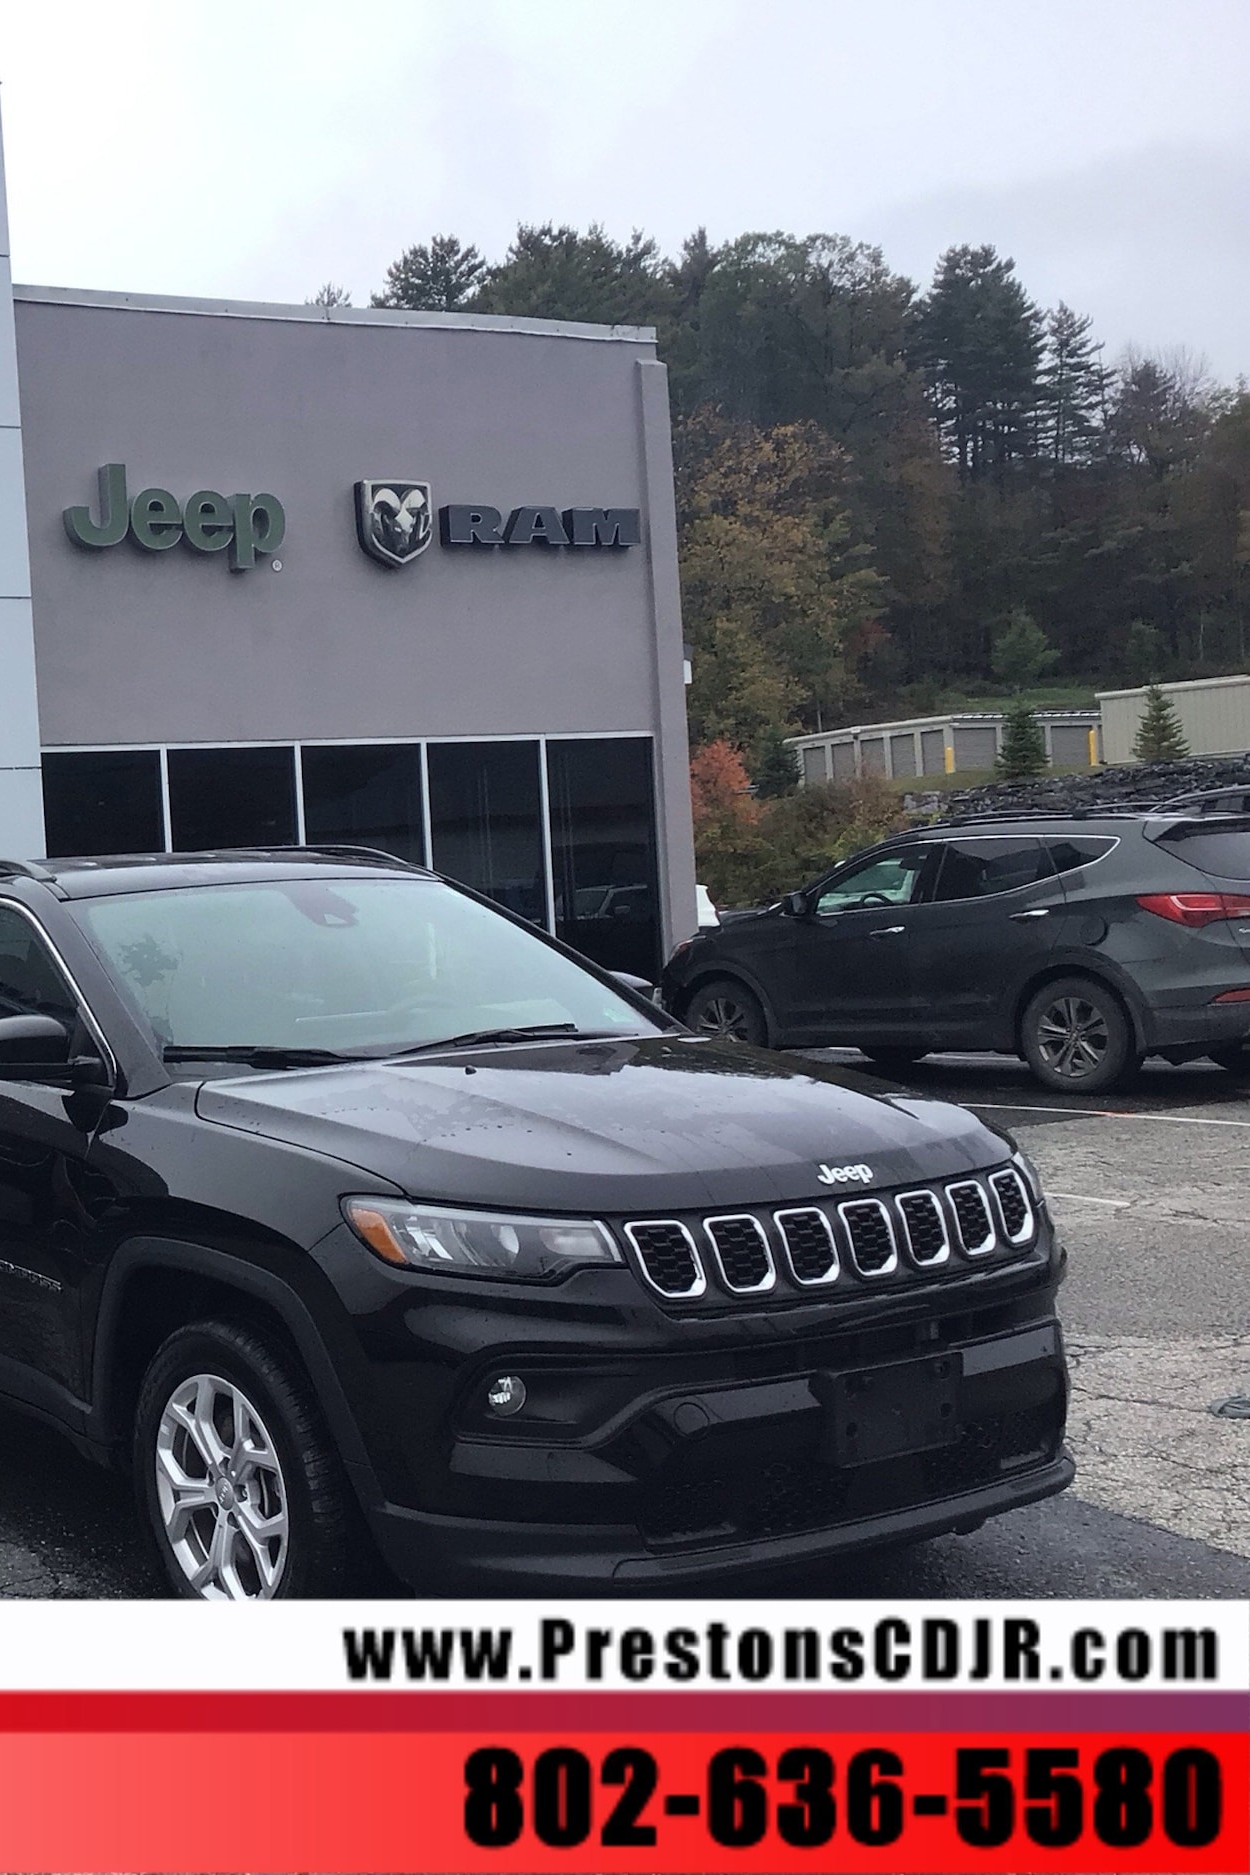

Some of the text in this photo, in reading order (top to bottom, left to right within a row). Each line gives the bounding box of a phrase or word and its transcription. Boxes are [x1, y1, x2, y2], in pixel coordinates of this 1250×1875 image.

[63, 463, 286, 573] Jeep
[440, 504, 641, 548] RAM
[817, 1163, 874, 1185] Jeep
